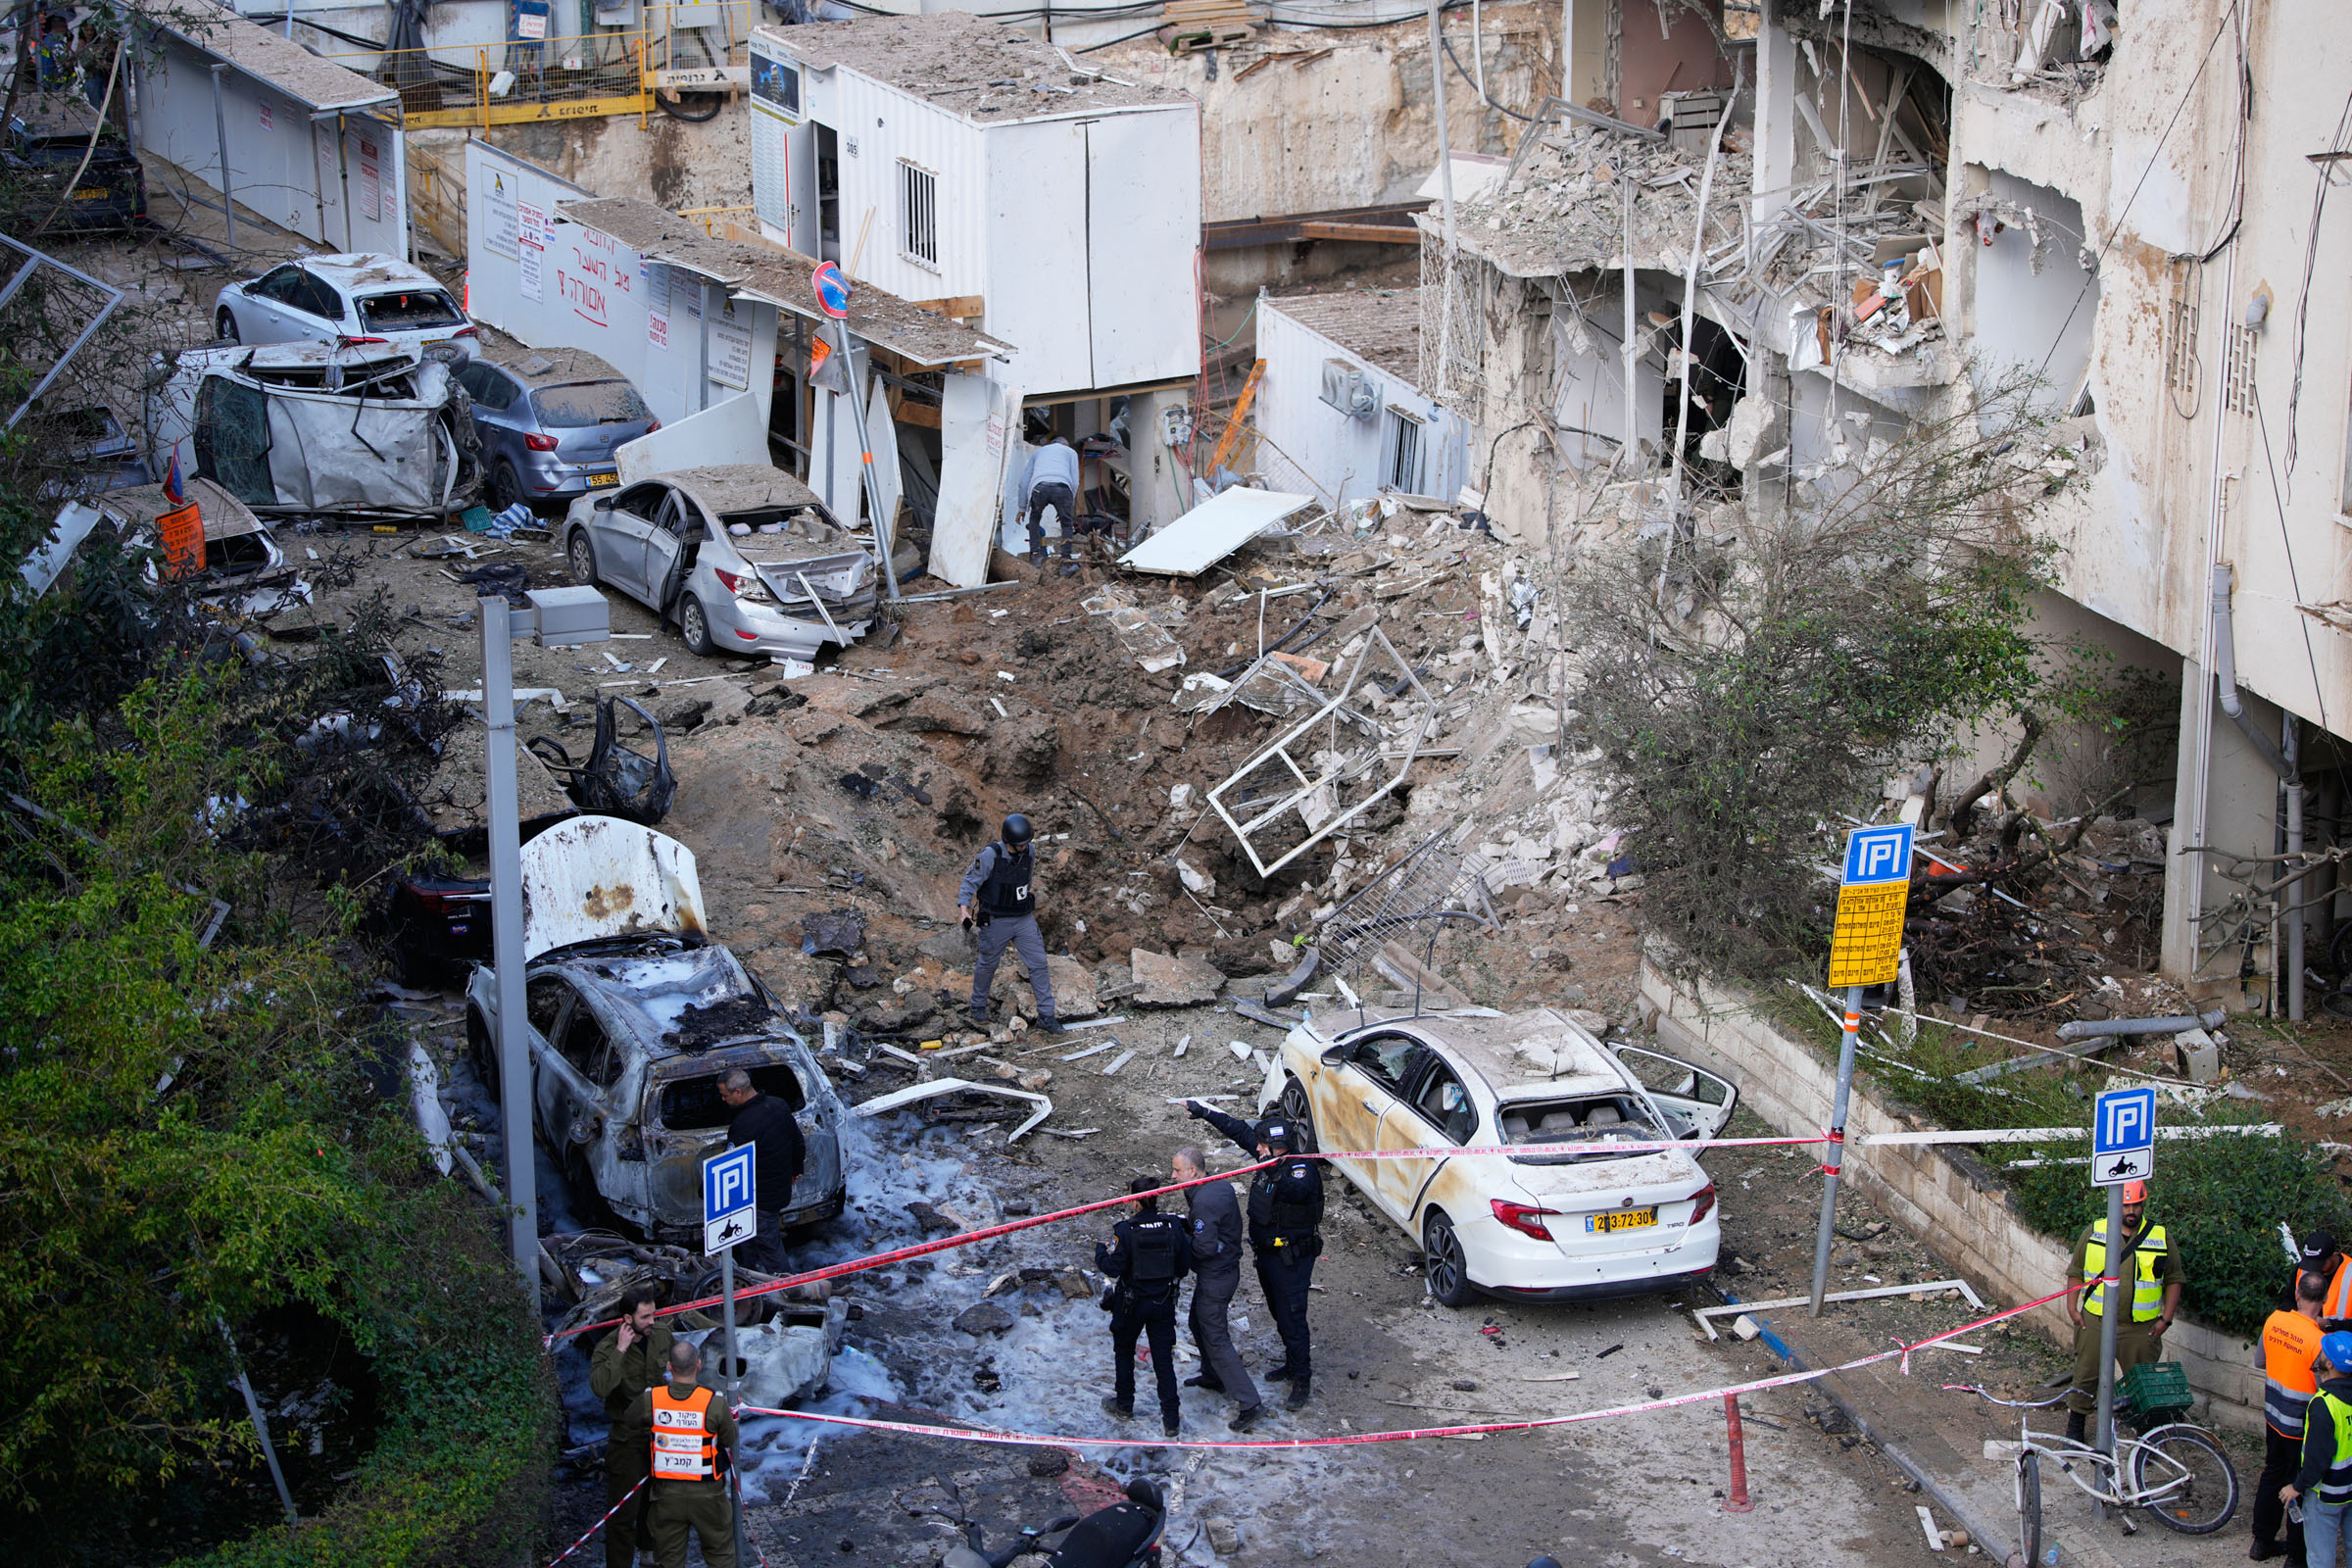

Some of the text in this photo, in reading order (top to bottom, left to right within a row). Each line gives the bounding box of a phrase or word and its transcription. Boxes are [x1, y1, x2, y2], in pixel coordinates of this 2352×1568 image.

[846, 141, 858, 156] 305
[572, 247, 607, 282] השער
[677, 1411, 697, 1420] פיקוד
[675, 1418, 698, 1427] העורף
[942, 1428, 972, 1438] משטרת
